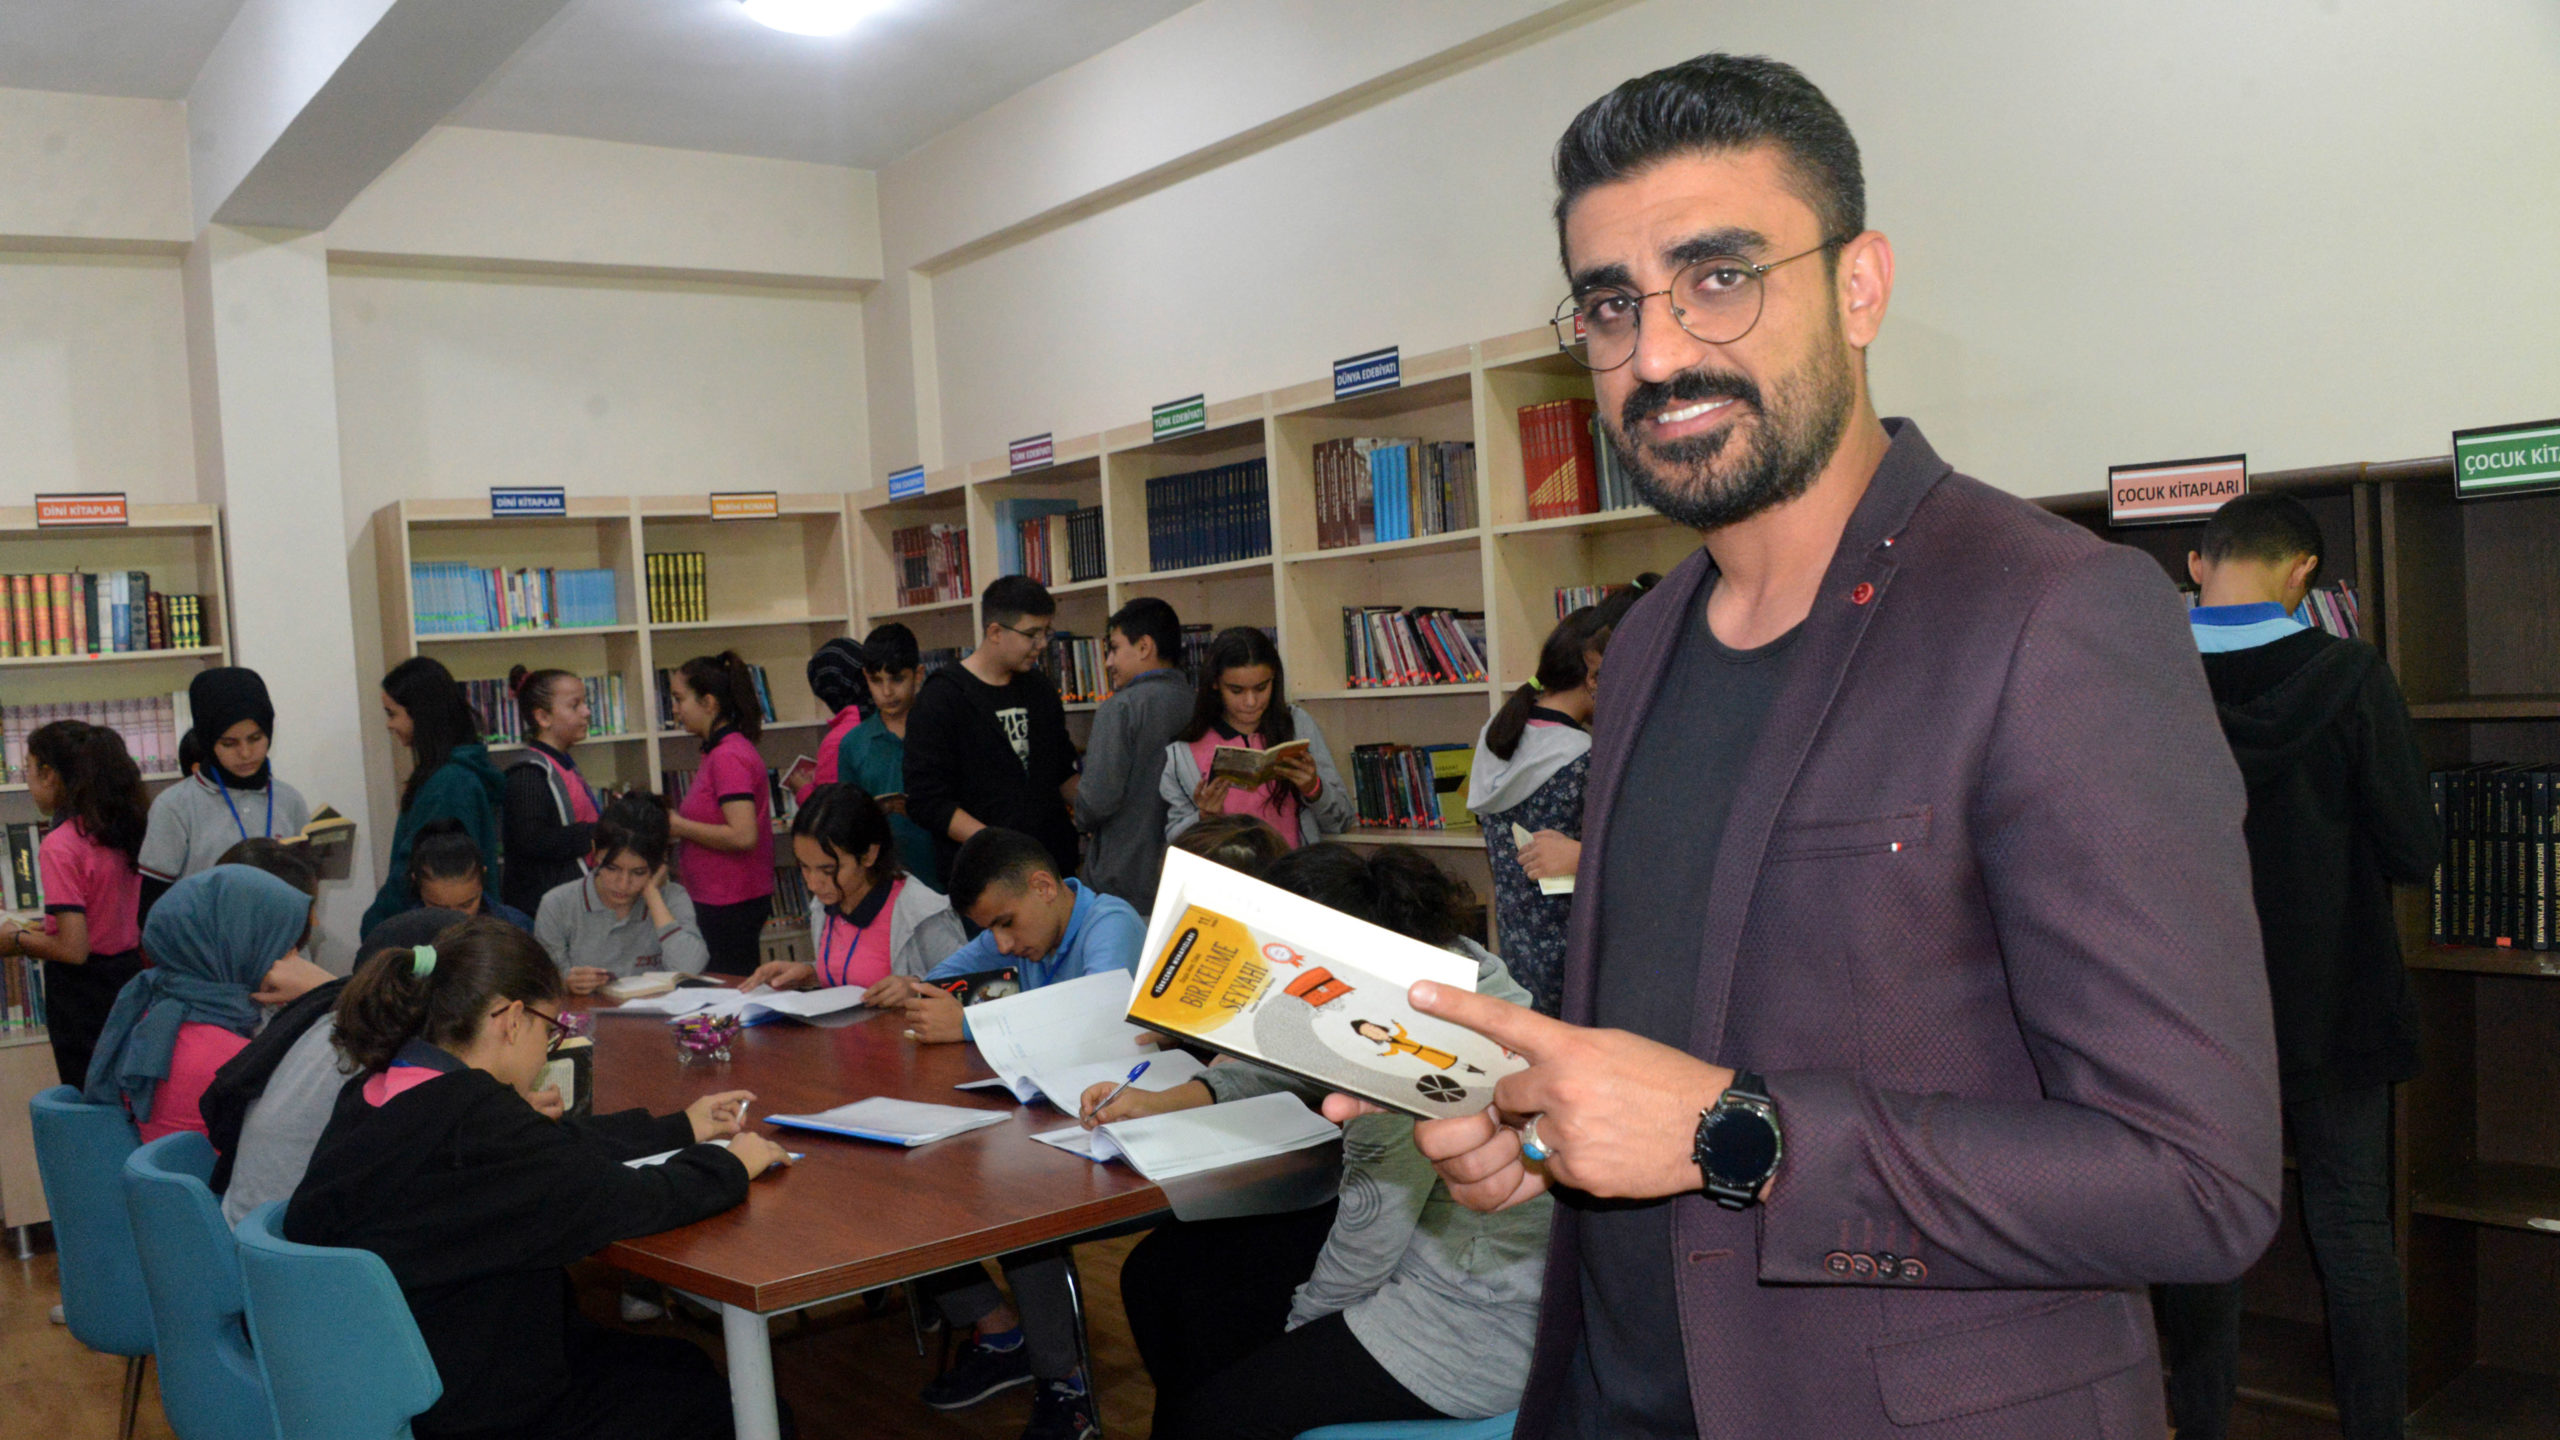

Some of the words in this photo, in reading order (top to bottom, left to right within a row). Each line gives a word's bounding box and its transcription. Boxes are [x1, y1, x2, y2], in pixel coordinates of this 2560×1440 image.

[1336, 370, 1362, 386] DÜNYA
[1361, 362, 1397, 380] EDEBİYATI
[1155, 416, 1171, 429] TÜRK
[1172, 408, 1204, 424] EDEBİYATI
[2464, 449, 2527, 475] ÇOCUK
[2531, 443, 2560, 465] KİT
[496, 496, 516, 508] DİNİ
[518, 496, 560, 507] KİTAPLAR
[2117, 486, 2165, 506] ÇOCUK
[2169, 480, 2240, 499] KİTAPLARI
[43, 504, 67, 516] DİNİ
[70, 503, 120, 516] KİTAPLAR
[2536, 843, 2545, 897] ANSİKLOPEDİSİ
[2434, 893, 2442, 935] HAYVANLAR
[2537, 900, 2545, 943] HAYVANLAR
[1154, 962, 1176, 995] TÜRKÇENİN
[1194, 941, 1239, 988] KELİME
[1180, 982, 1211, 1008] BİR
[1219, 961, 1269, 1013] SEYYAHI
